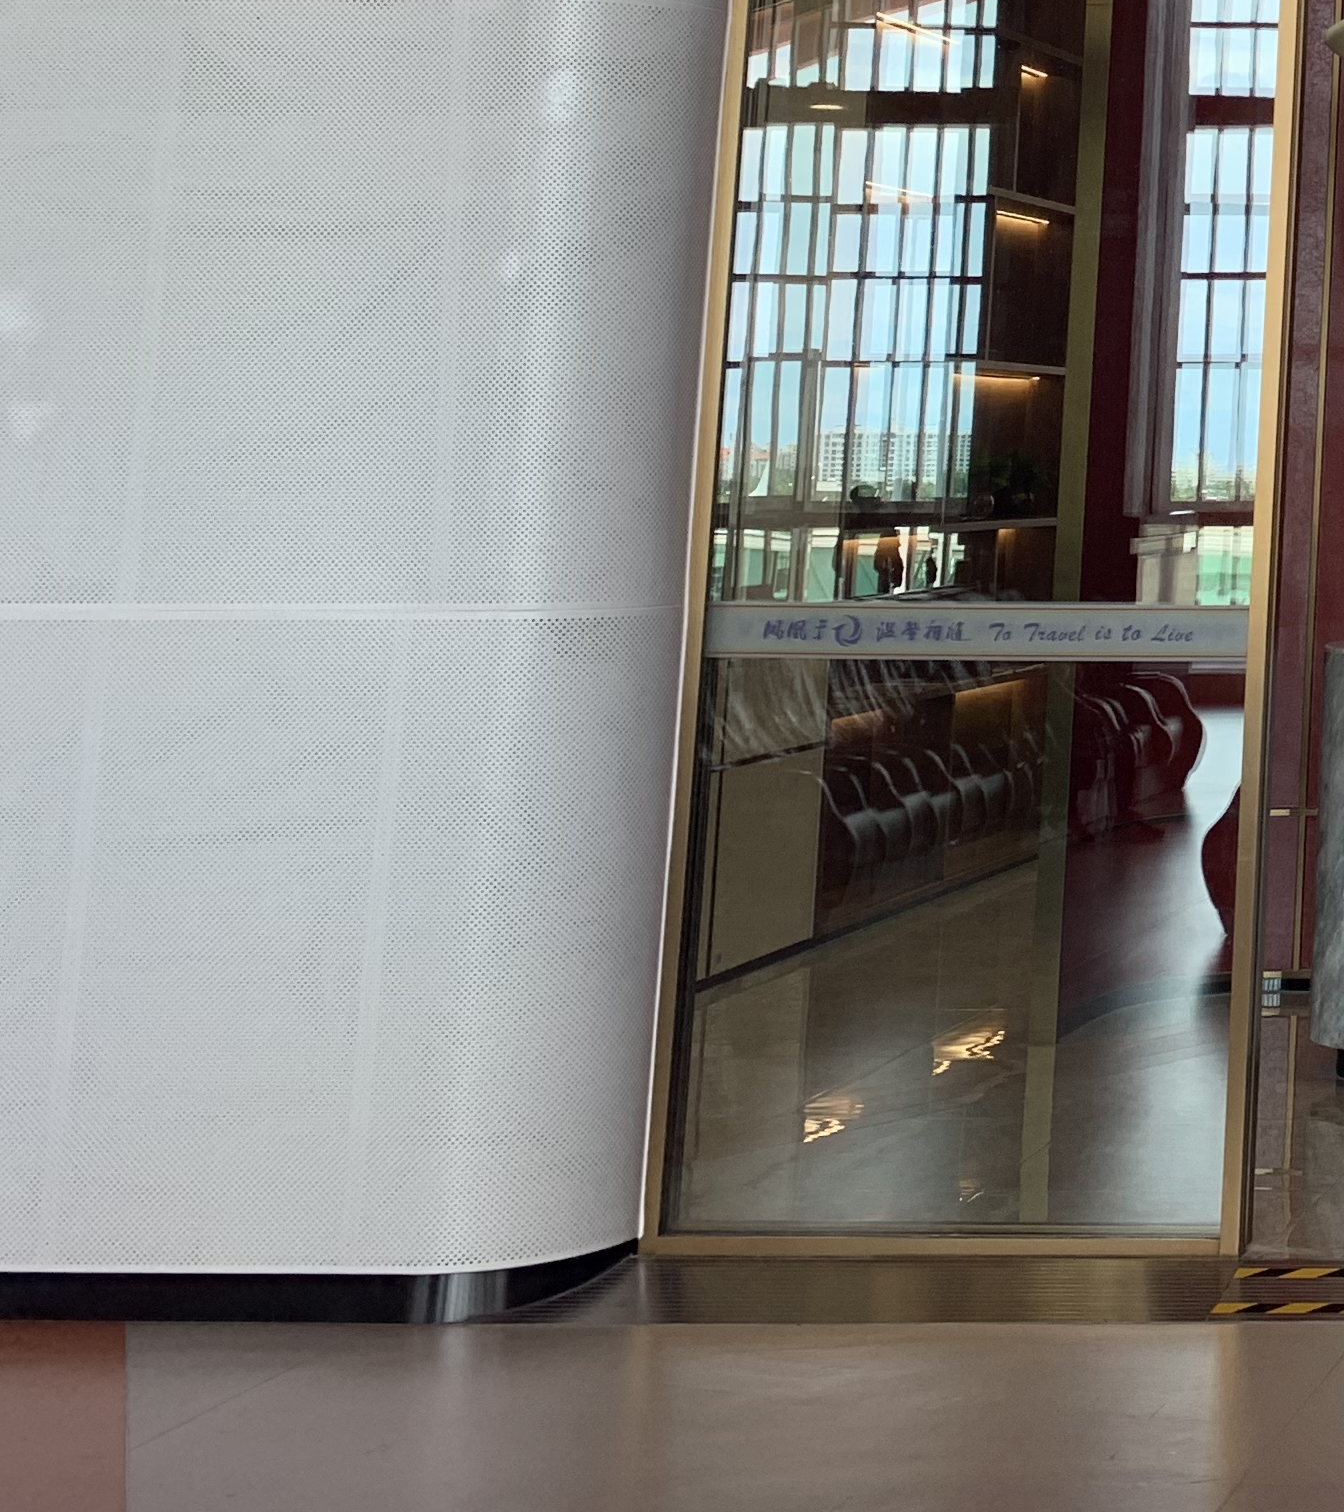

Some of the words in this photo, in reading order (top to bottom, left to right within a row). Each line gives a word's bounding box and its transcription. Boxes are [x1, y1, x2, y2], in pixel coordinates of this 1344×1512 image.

[989, 622, 1012, 641] To
[1024, 622, 1086, 641] Travel
[1095, 626, 1113, 641] is
[1122, 625, 1142, 641] to
[1151, 624, 1194, 641] Live
